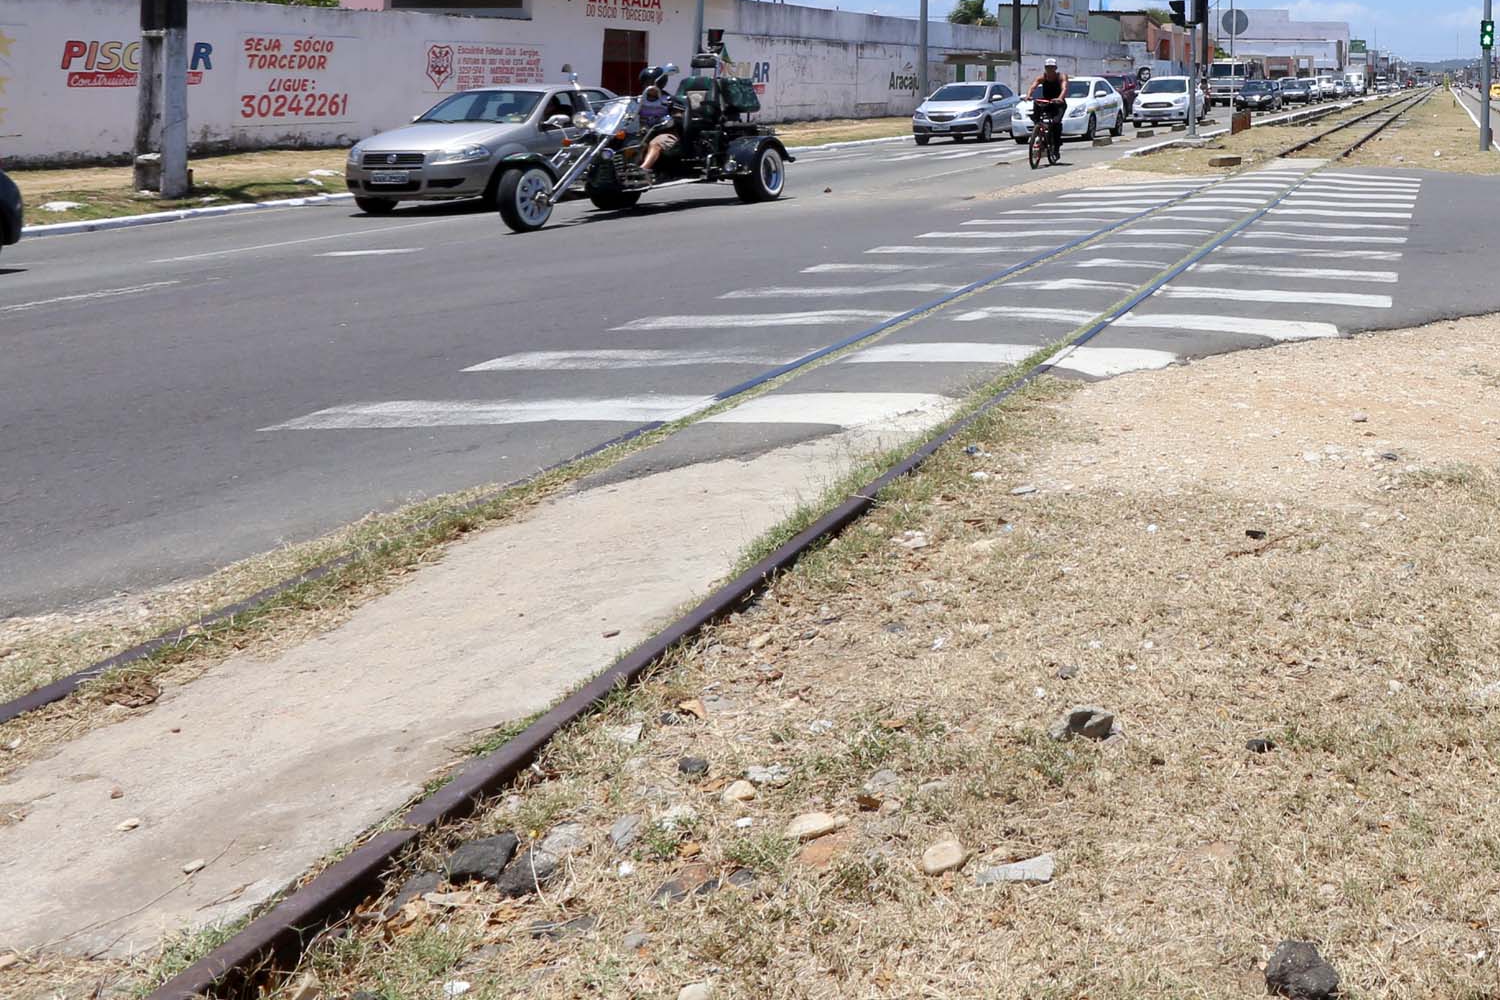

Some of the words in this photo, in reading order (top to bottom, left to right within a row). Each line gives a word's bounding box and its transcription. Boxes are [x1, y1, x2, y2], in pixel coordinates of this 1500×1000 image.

[586, 3, 596, 17] DO
[619, 7, 655, 23] TORCEDOR
[244, 38, 282, 52] SEJA
[293, 34, 334, 53] SÓCIO
[247, 54, 328, 70] TORCEDOR
[268, 78, 316, 92] LIGUE:
[888, 71, 920, 97] Aracaju
[240, 93, 349, 118] 30242261
